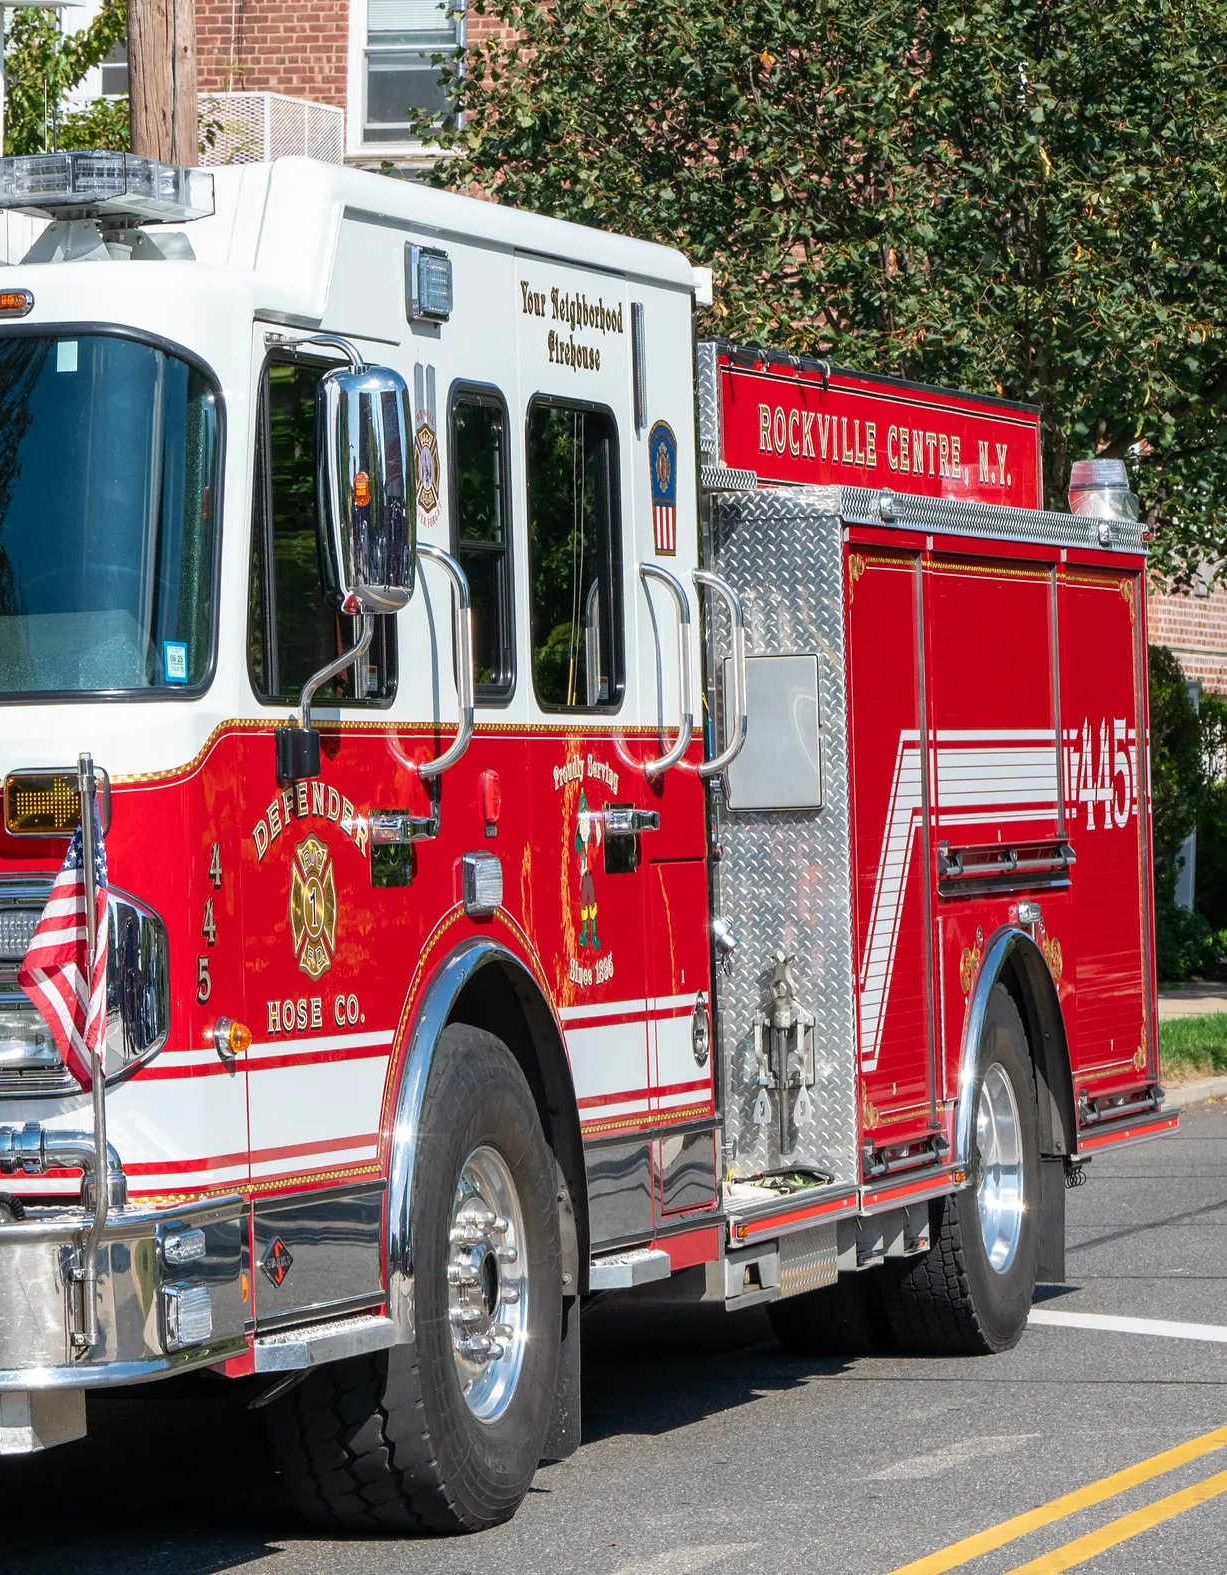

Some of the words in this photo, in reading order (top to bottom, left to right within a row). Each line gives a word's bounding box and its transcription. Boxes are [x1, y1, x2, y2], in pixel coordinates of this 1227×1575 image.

[520, 280, 546, 316] Your
[551, 287, 623, 335] Neighborhood
[547, 329, 601, 372] Firehouse
[758, 403, 877, 468] ROCKVILLE
[887, 425, 969, 486] CENTRE,
[978, 440, 1012, 487] N.Y.
[553, 754, 585, 791] Proudly
[587, 753, 619, 796] Serving
[1078, 716, 1131, 831] 445
[252, 782, 370, 862] DEFENDER
[309, 887, 319, 927] 1
[570, 957, 593, 988] Since
[267, 998, 323, 1033] HOSE
[334, 994, 366, 1025] CO.
